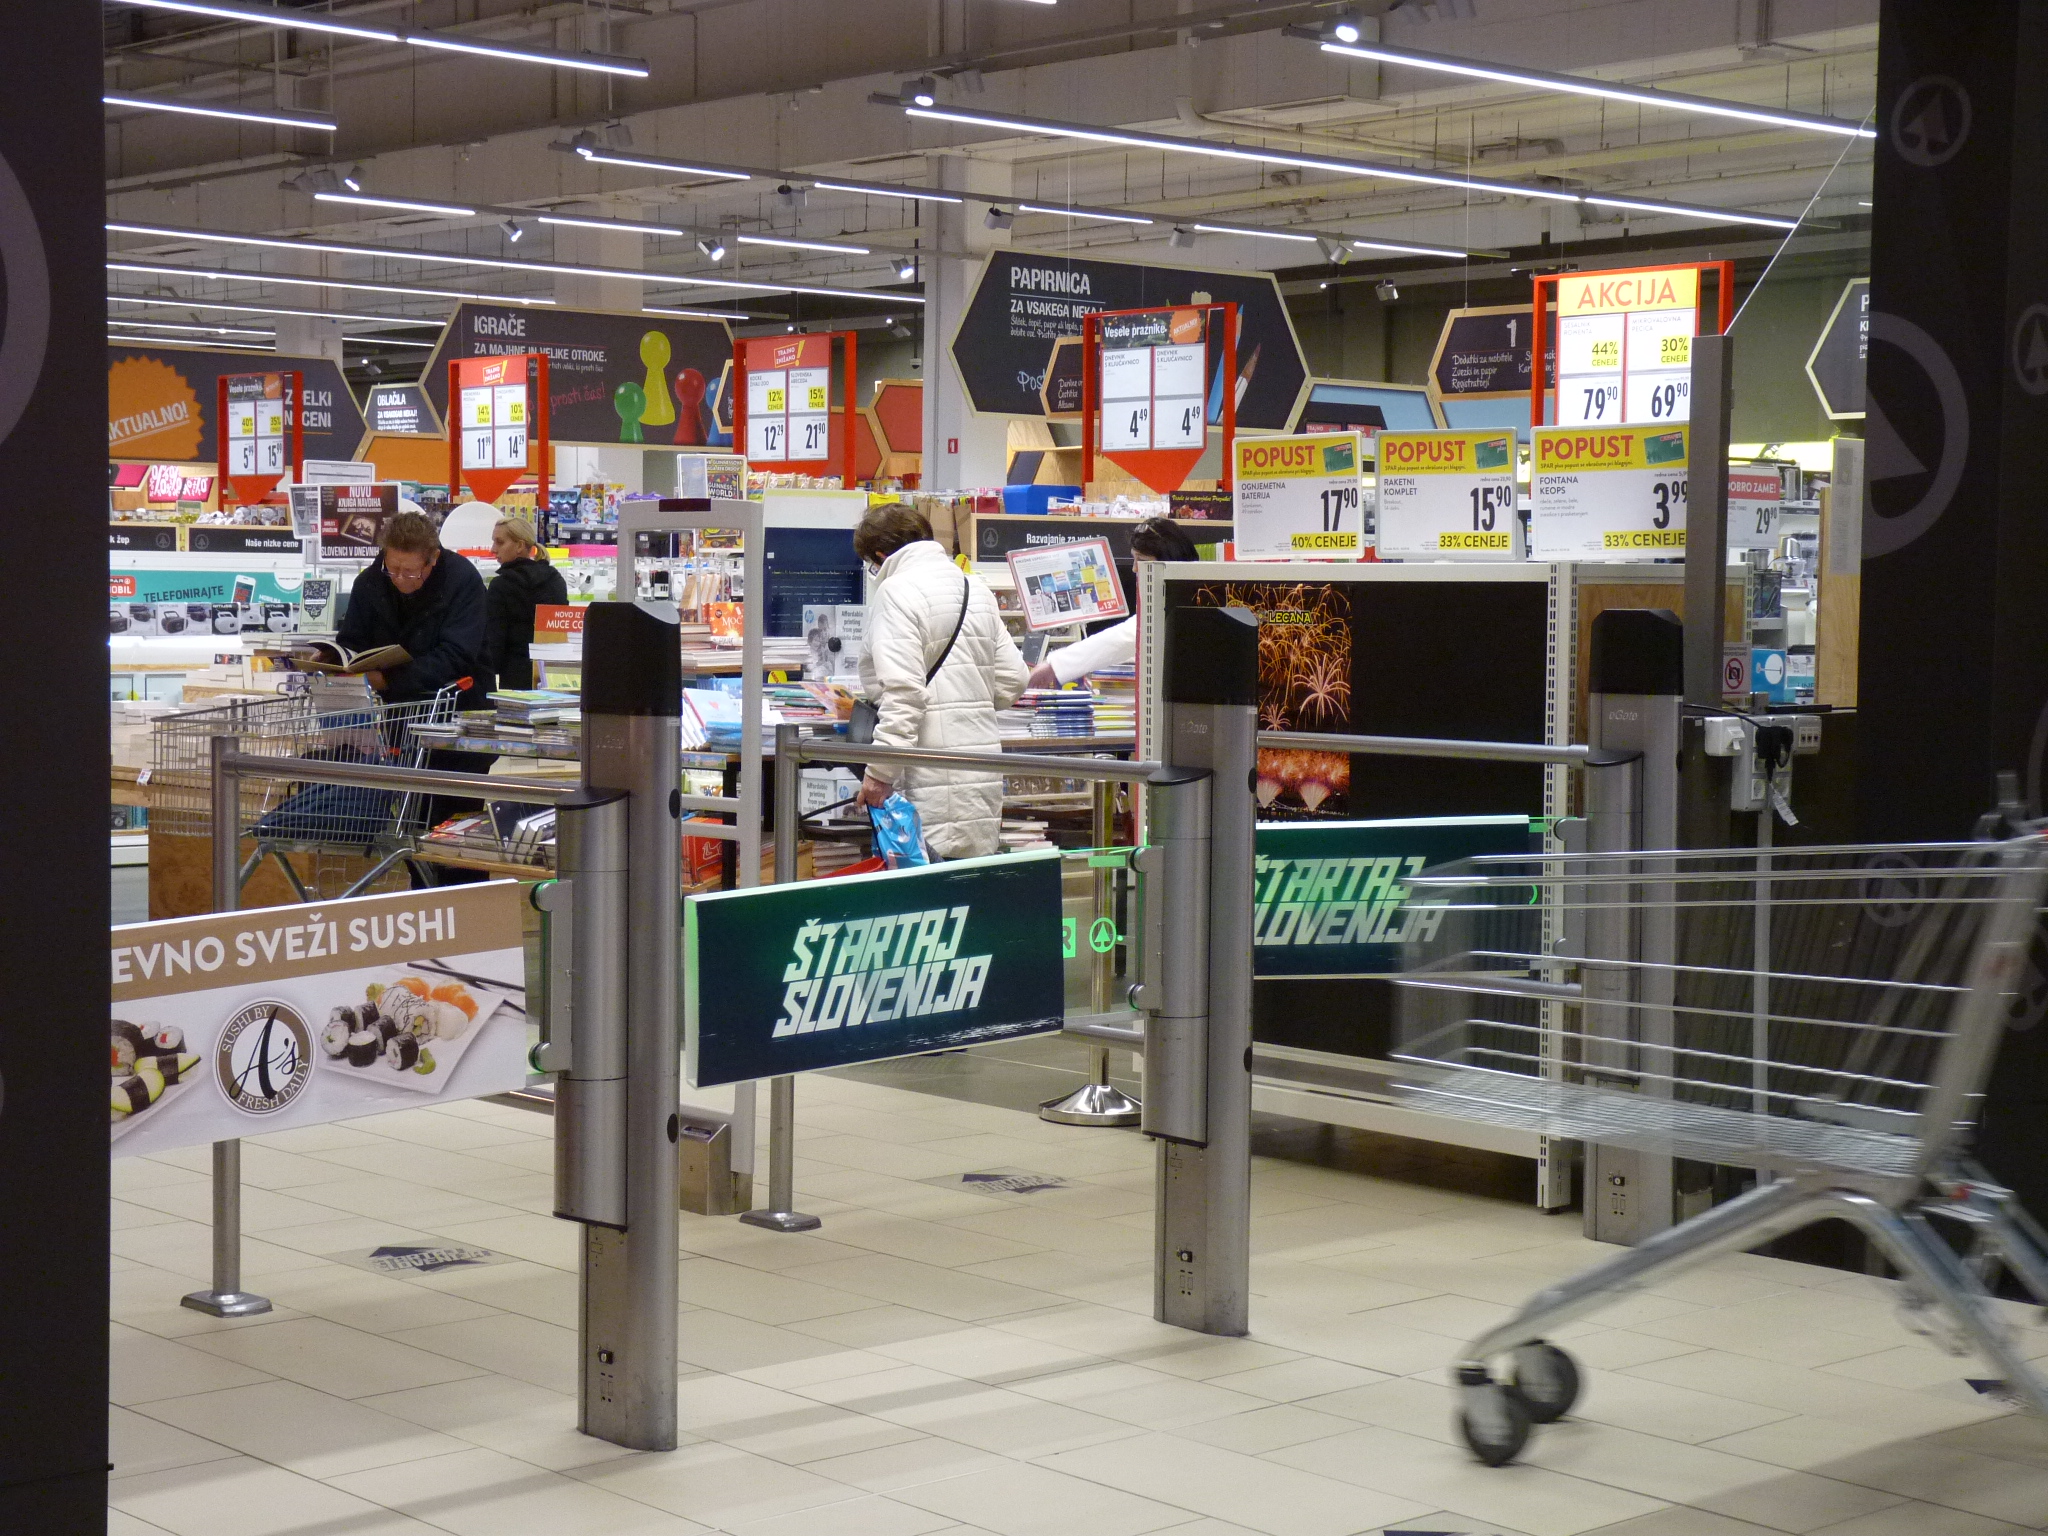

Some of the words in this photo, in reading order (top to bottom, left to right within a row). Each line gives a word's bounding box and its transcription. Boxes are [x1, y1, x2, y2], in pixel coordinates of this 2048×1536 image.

[1010, 266, 1091, 296] PAPIRNICA
[1577, 277, 1677, 310] AKCIJA
[1010, 299, 1024, 314] ZA
[1026, 300, 1070, 318] VSAKEGA
[474, 313, 526, 337] IGRAČE
[1104, 326, 1130, 339] Vesele
[1506, 319, 1517, 348] 1
[1591, 340, 1618, 356] 44%
[1661, 336, 1689, 353] 30%
[474, 342, 487, 355] ZA
[571, 349, 608, 363] OTROKE.
[1104, 353, 1126, 361] DNEVNIK
[1156, 349, 1179, 357] DNEVNIK
[1108, 357, 1140, 368] KLJUČAVNICO
[1160, 354, 1193, 364] KLJUČAVNICO
[1591, 358, 1618, 367] CENEJE
[1660, 354, 1689, 363] CENEJE
[1451, 366, 1473, 377] Zvezki
[377, 390, 406, 407] OBLAČILA
[768, 390, 783, 402] 12%
[809, 388, 824, 400] 15%
[477, 405, 490, 416] 14%
[510, 403, 523, 414] 10%
[767, 403, 784, 411] CENEJE
[808, 401, 825, 409] CENEJE
[241, 417, 254, 427] 40%
[270, 415, 282, 426] 35%
[302, 411, 331, 428] CENI
[1385, 440, 1467, 464] POPUST
[1540, 434, 1634, 461] POPUST
[1242, 444, 1316, 469] POPUST
[1241, 482, 1286, 491] OGNJEMETNA
[1383, 478, 1415, 487] RAKETNI
[1539, 476, 1579, 486] FONTANA
[708, 489, 734, 497] WORLD
[1383, 487, 1418, 497] KOMPLET
[1539, 486, 1566, 495] KEOPS
[1753, 483, 1777, 494] ZAME!
[1241, 491, 1271, 500] BATERIJA
[116, 535, 130, 545] žep
[245, 538, 262, 548] Naše
[263, 540, 282, 548] nizke
[1026, 533, 1066, 546] Razvajanje
[1291, 536, 1313, 549] 40%
[1315, 534, 1357, 548] CENEJE
[1439, 535, 1461, 548] 33%
[1463, 535, 1508, 548] CENEJE
[1604, 534, 1630, 548] 33%
[1632, 531, 1686, 547] CENEJE
[321, 546, 348, 557] SLOVENCI
[143, 585, 225, 603] TELEFONIRAJTE
[554, 611, 574, 619] NOVO
[545, 620, 570, 629] MUCE
[110, 936, 225, 985] EVNO
[235, 912, 338, 968] SVEŽI
[348, 906, 456, 953] SUSHI
[782, 905, 970, 983] ŠTARTAJ
[771, 954, 994, 1038] SLOVENIJA
[221, 1011, 253, 1053] SUSHI
[253, 1005, 271, 1020] BY
[237, 1093, 281, 1110] FRESH
[281, 1057, 310, 1100] DAILY
